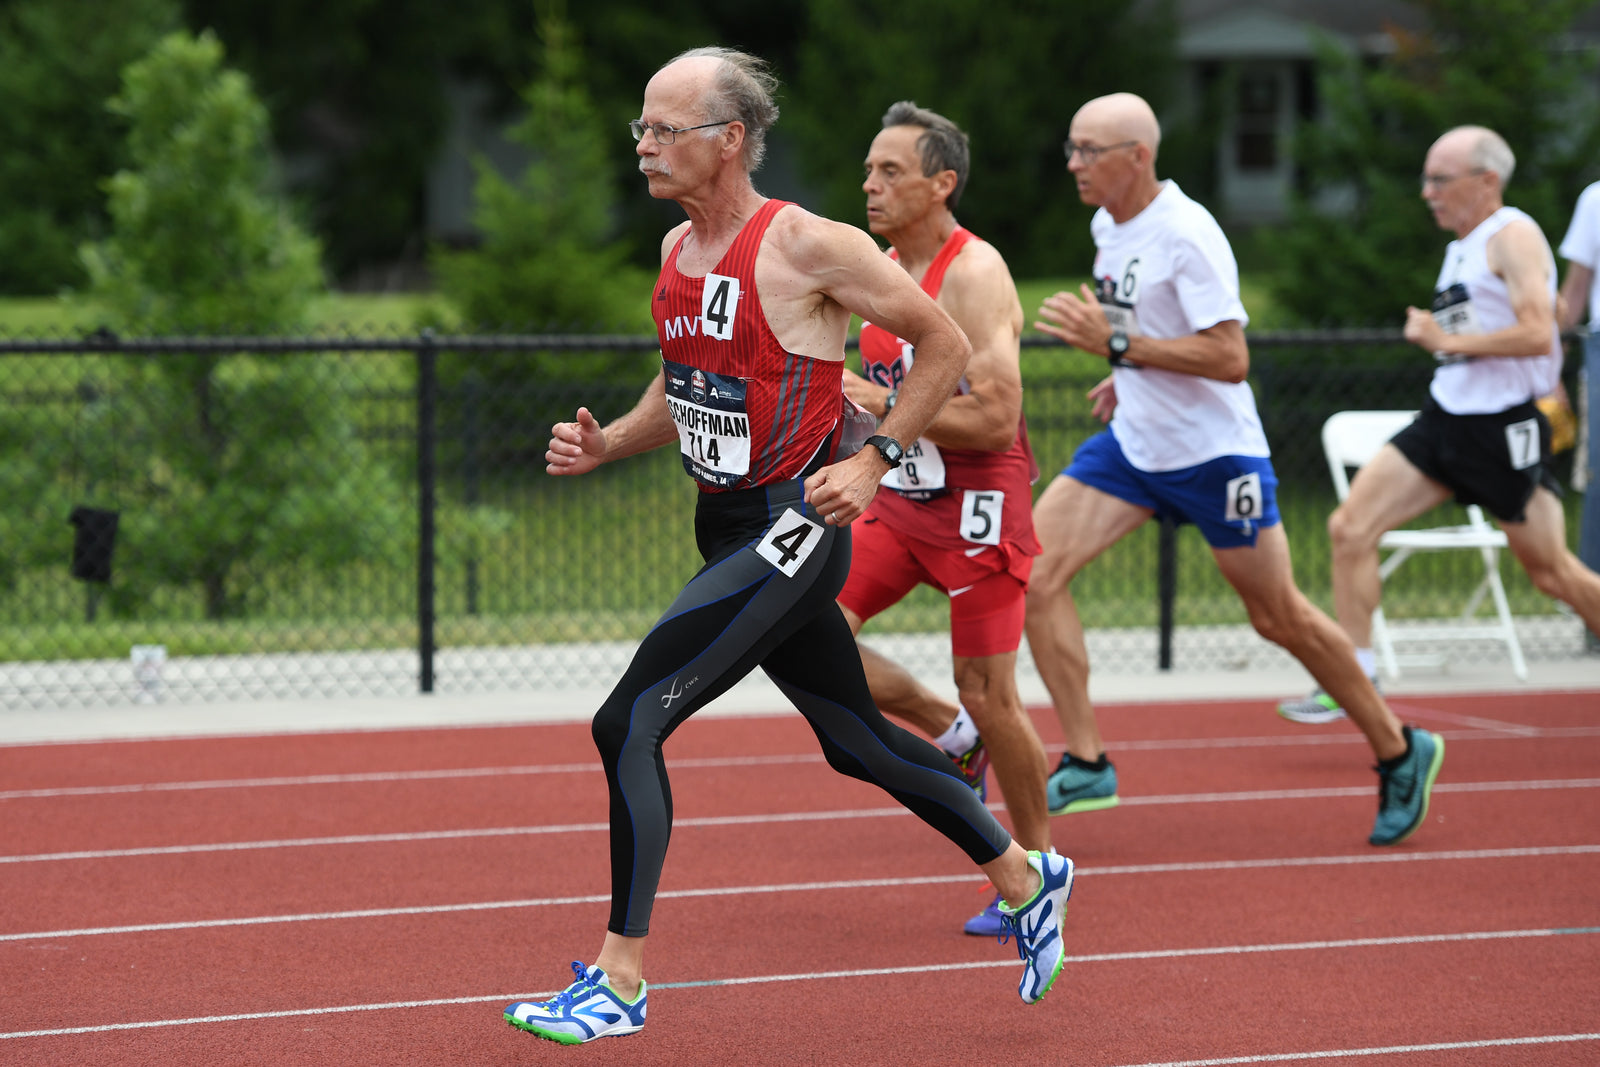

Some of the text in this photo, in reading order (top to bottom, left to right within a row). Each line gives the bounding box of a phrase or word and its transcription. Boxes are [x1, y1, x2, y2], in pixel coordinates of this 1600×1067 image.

[1123, 257, 1140, 297] 6
[706, 279, 731, 335] 4
[665, 315, 722, 341] MV
[667, 399, 748, 438] SCHOFFMAN
[687, 431, 721, 467] 714
[1515, 428, 1532, 464] 7
[969, 494, 994, 540] 5
[1235, 480, 1254, 516] 6
[770, 522, 814, 568] 4
